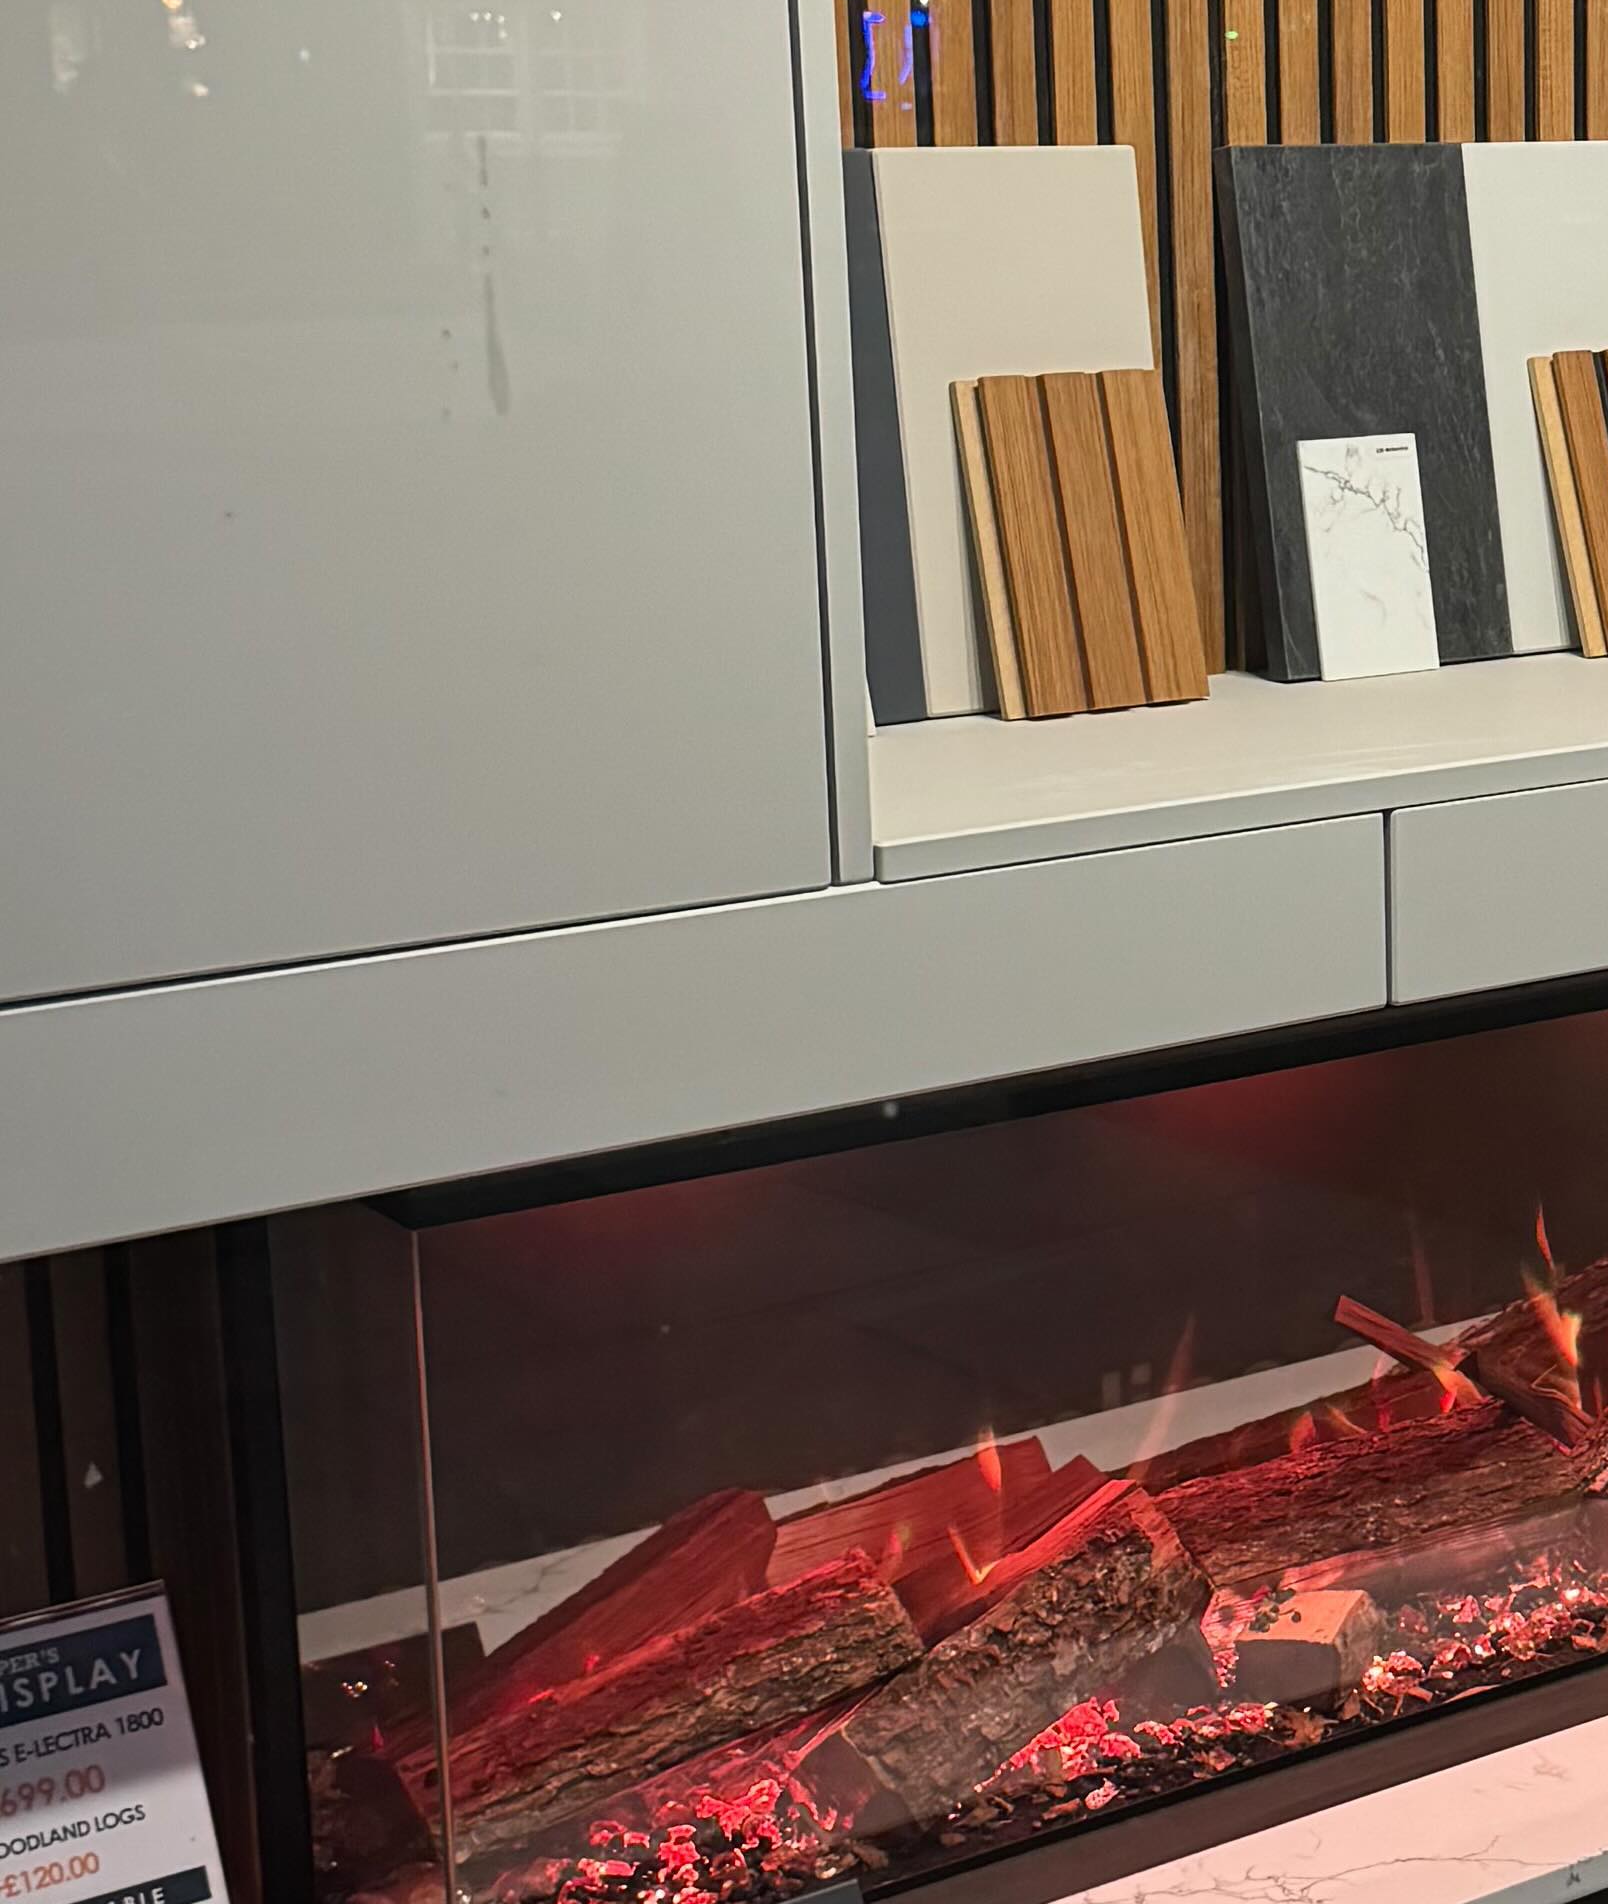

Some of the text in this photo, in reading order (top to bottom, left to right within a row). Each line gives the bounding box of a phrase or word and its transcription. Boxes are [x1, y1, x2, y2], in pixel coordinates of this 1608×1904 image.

[14, 1725, 111, 1763] E-LECTRA
[115, 1707, 164, 1735] 1800
[94, 1804, 147, 1832] LOGS
